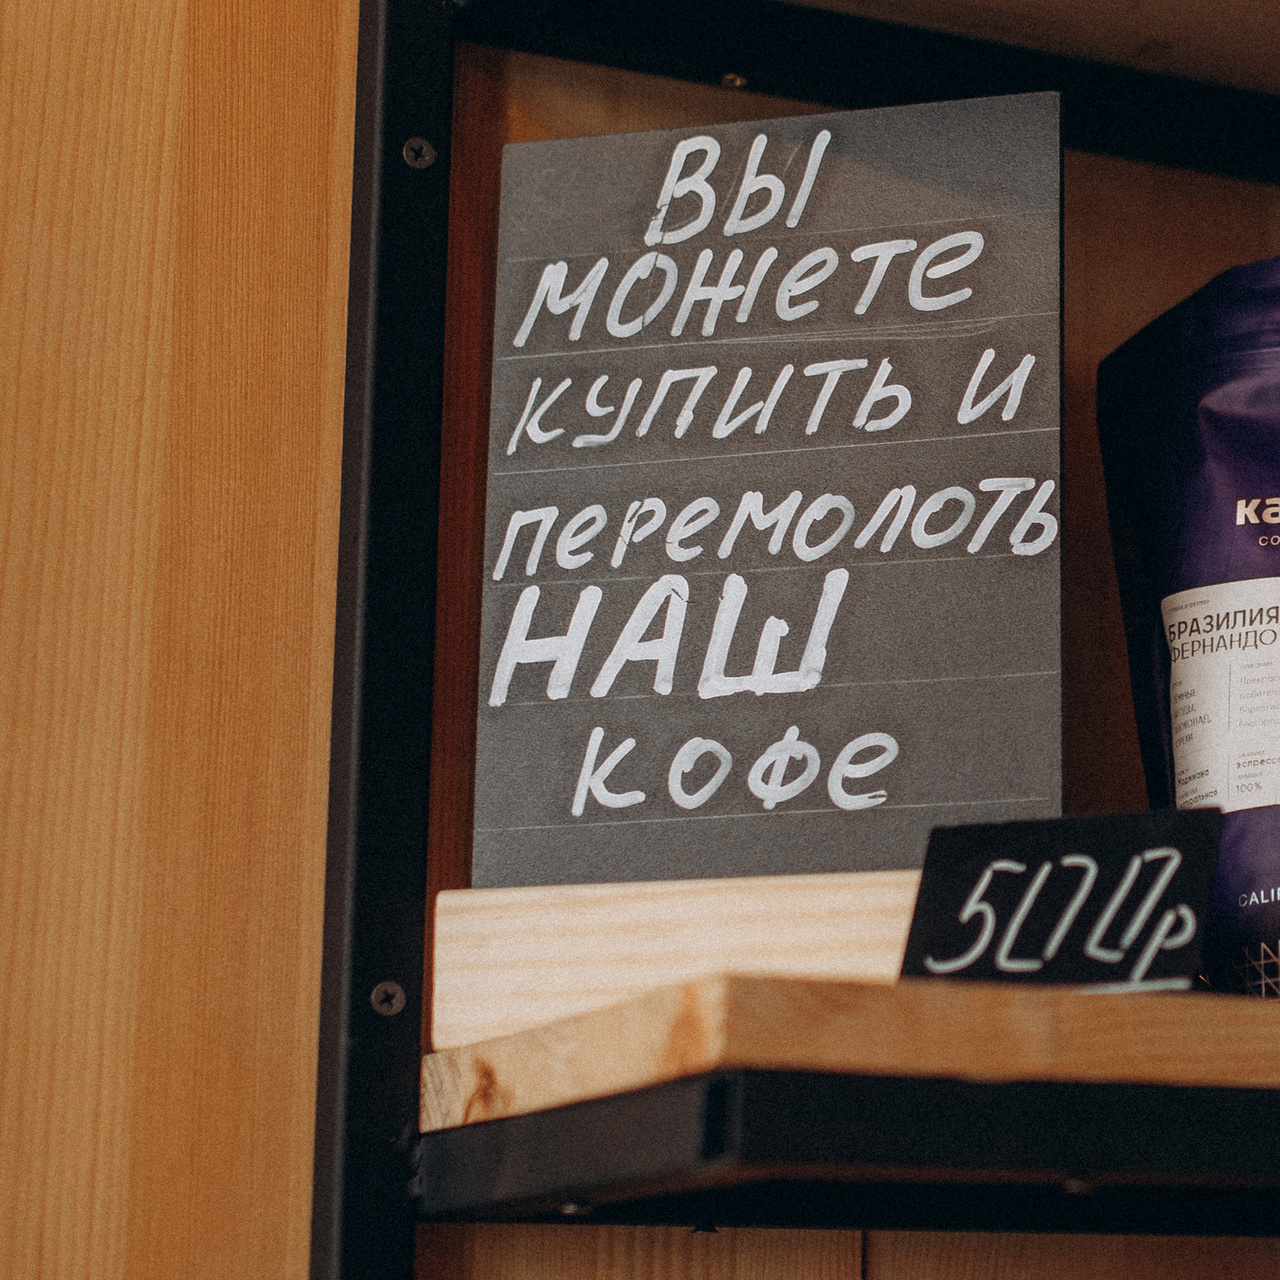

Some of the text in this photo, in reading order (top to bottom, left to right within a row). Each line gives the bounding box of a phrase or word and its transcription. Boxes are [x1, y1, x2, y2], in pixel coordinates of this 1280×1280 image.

[489, 569, 849, 706] НАШ
[1168, 606, 1280, 643] БРАЗИЛИЯ
[1171, 628, 1277, 663] ФЕРНАНДО
[1236, 781, 1263, 793] 100%
